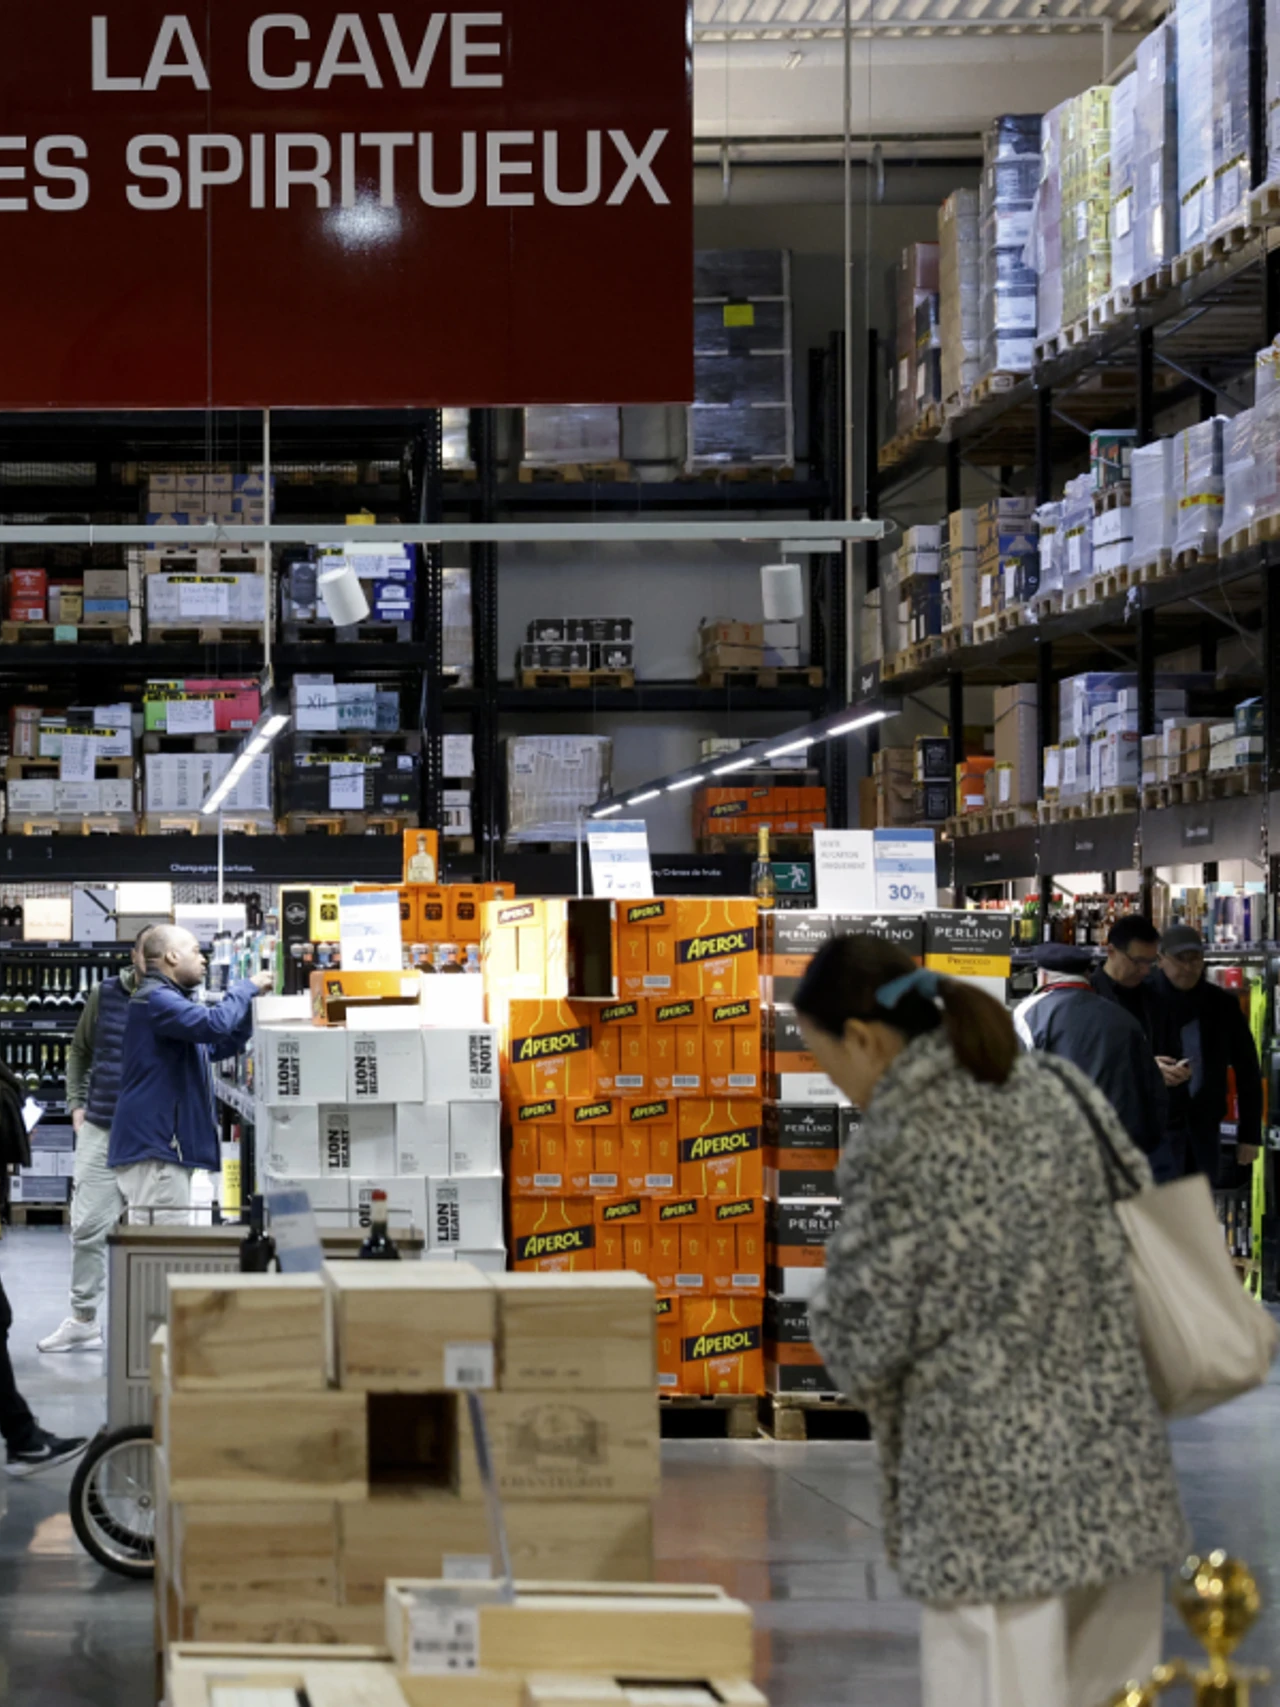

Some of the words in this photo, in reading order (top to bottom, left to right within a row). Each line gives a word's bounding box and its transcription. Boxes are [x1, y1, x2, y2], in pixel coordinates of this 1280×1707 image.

[92, 15, 210, 91] LA
[248, 13, 504, 89] CAVE
[125, 129, 670, 210] SPIRITUEUX
[888, 884, 912, 901] 30
[629, 904, 663, 920] APEROL
[934, 926, 1004, 940] PERLINO
[687, 936, 748, 960] APEROL
[658, 1003, 693, 1020] APEROL
[714, 1003, 749, 1020] APEROL
[479, 1035, 492, 1074] LION
[520, 1031, 580, 1060] APEROL
[277, 1057, 290, 1096] LION
[355, 1056, 368, 1095] LION
[576, 1104, 610, 1121] APEROL
[784, 1124, 833, 1133] PERLINO
[328, 1129, 340, 1168] LION
[691, 1132, 750, 1159] APEROL
[437, 1202, 449, 1242] LION
[524, 1230, 584, 1257] APEROL
[693, 1330, 752, 1358] APEROL
